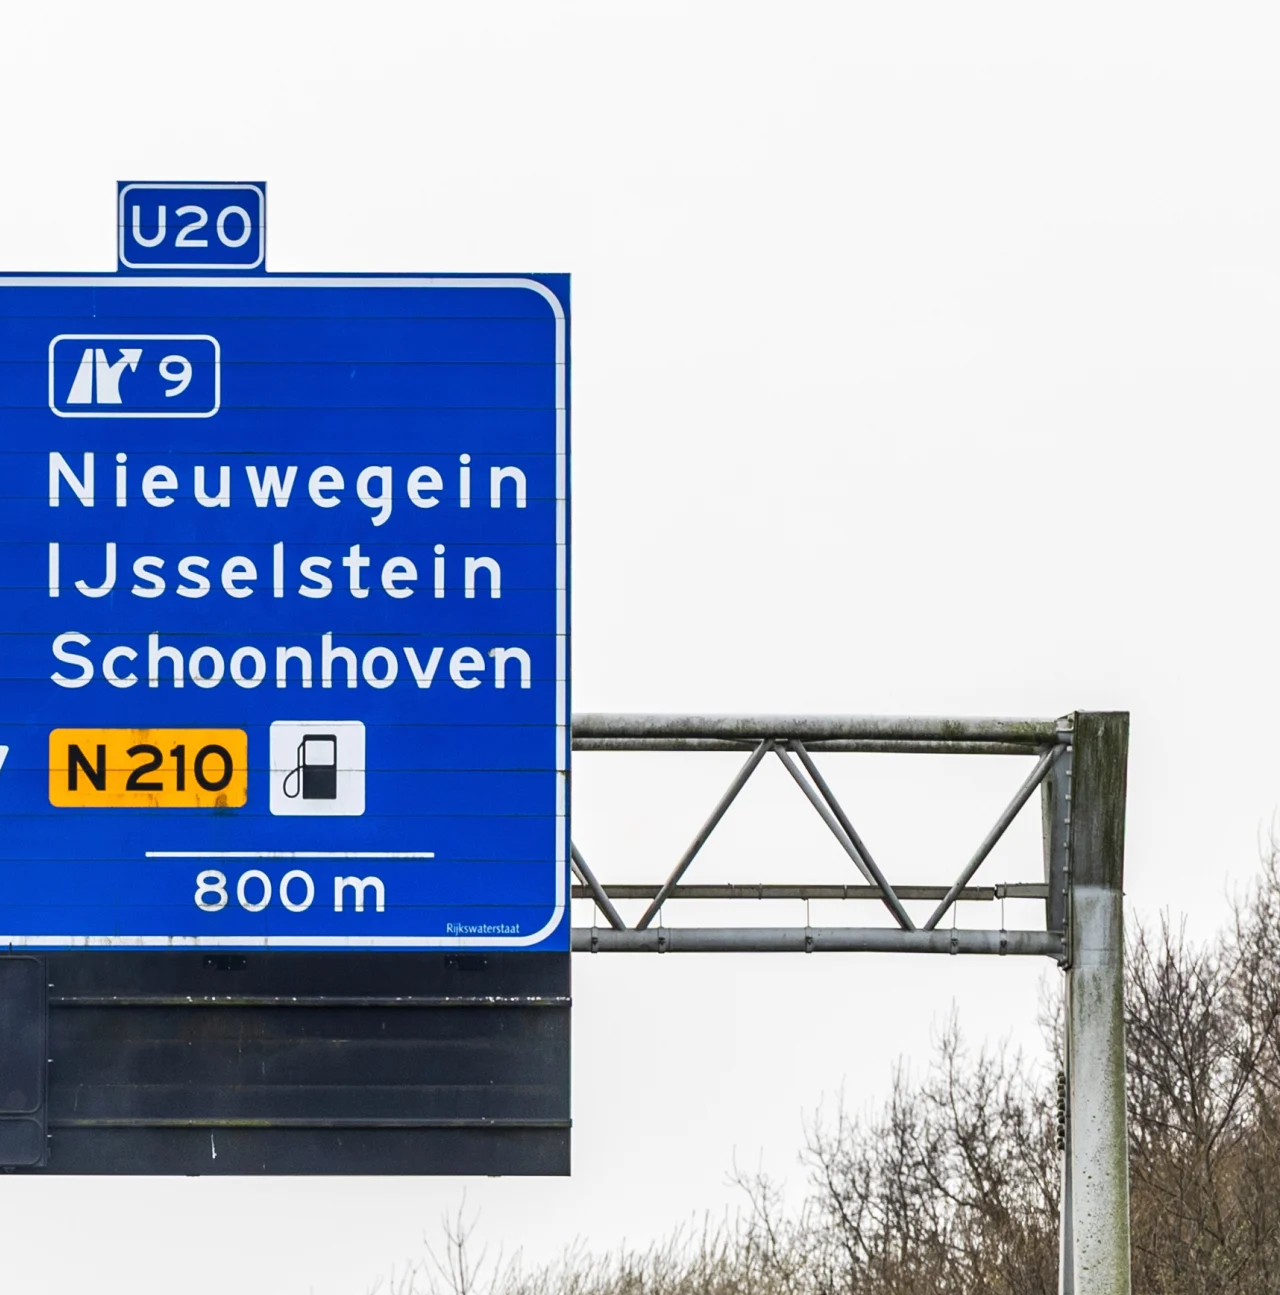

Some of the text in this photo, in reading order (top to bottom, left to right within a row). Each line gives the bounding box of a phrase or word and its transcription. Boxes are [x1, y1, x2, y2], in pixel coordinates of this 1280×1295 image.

[132, 205, 252, 248] U20
[158, 354, 193, 397] 9
[49, 451, 528, 527] Nieuwegein
[48, 541, 502, 599] IJsselstein
[50, 631, 532, 689] Schoonhoven
[194, 869, 385, 913] 800 m
[445, 921, 520, 936] Rijkswaterstaat
